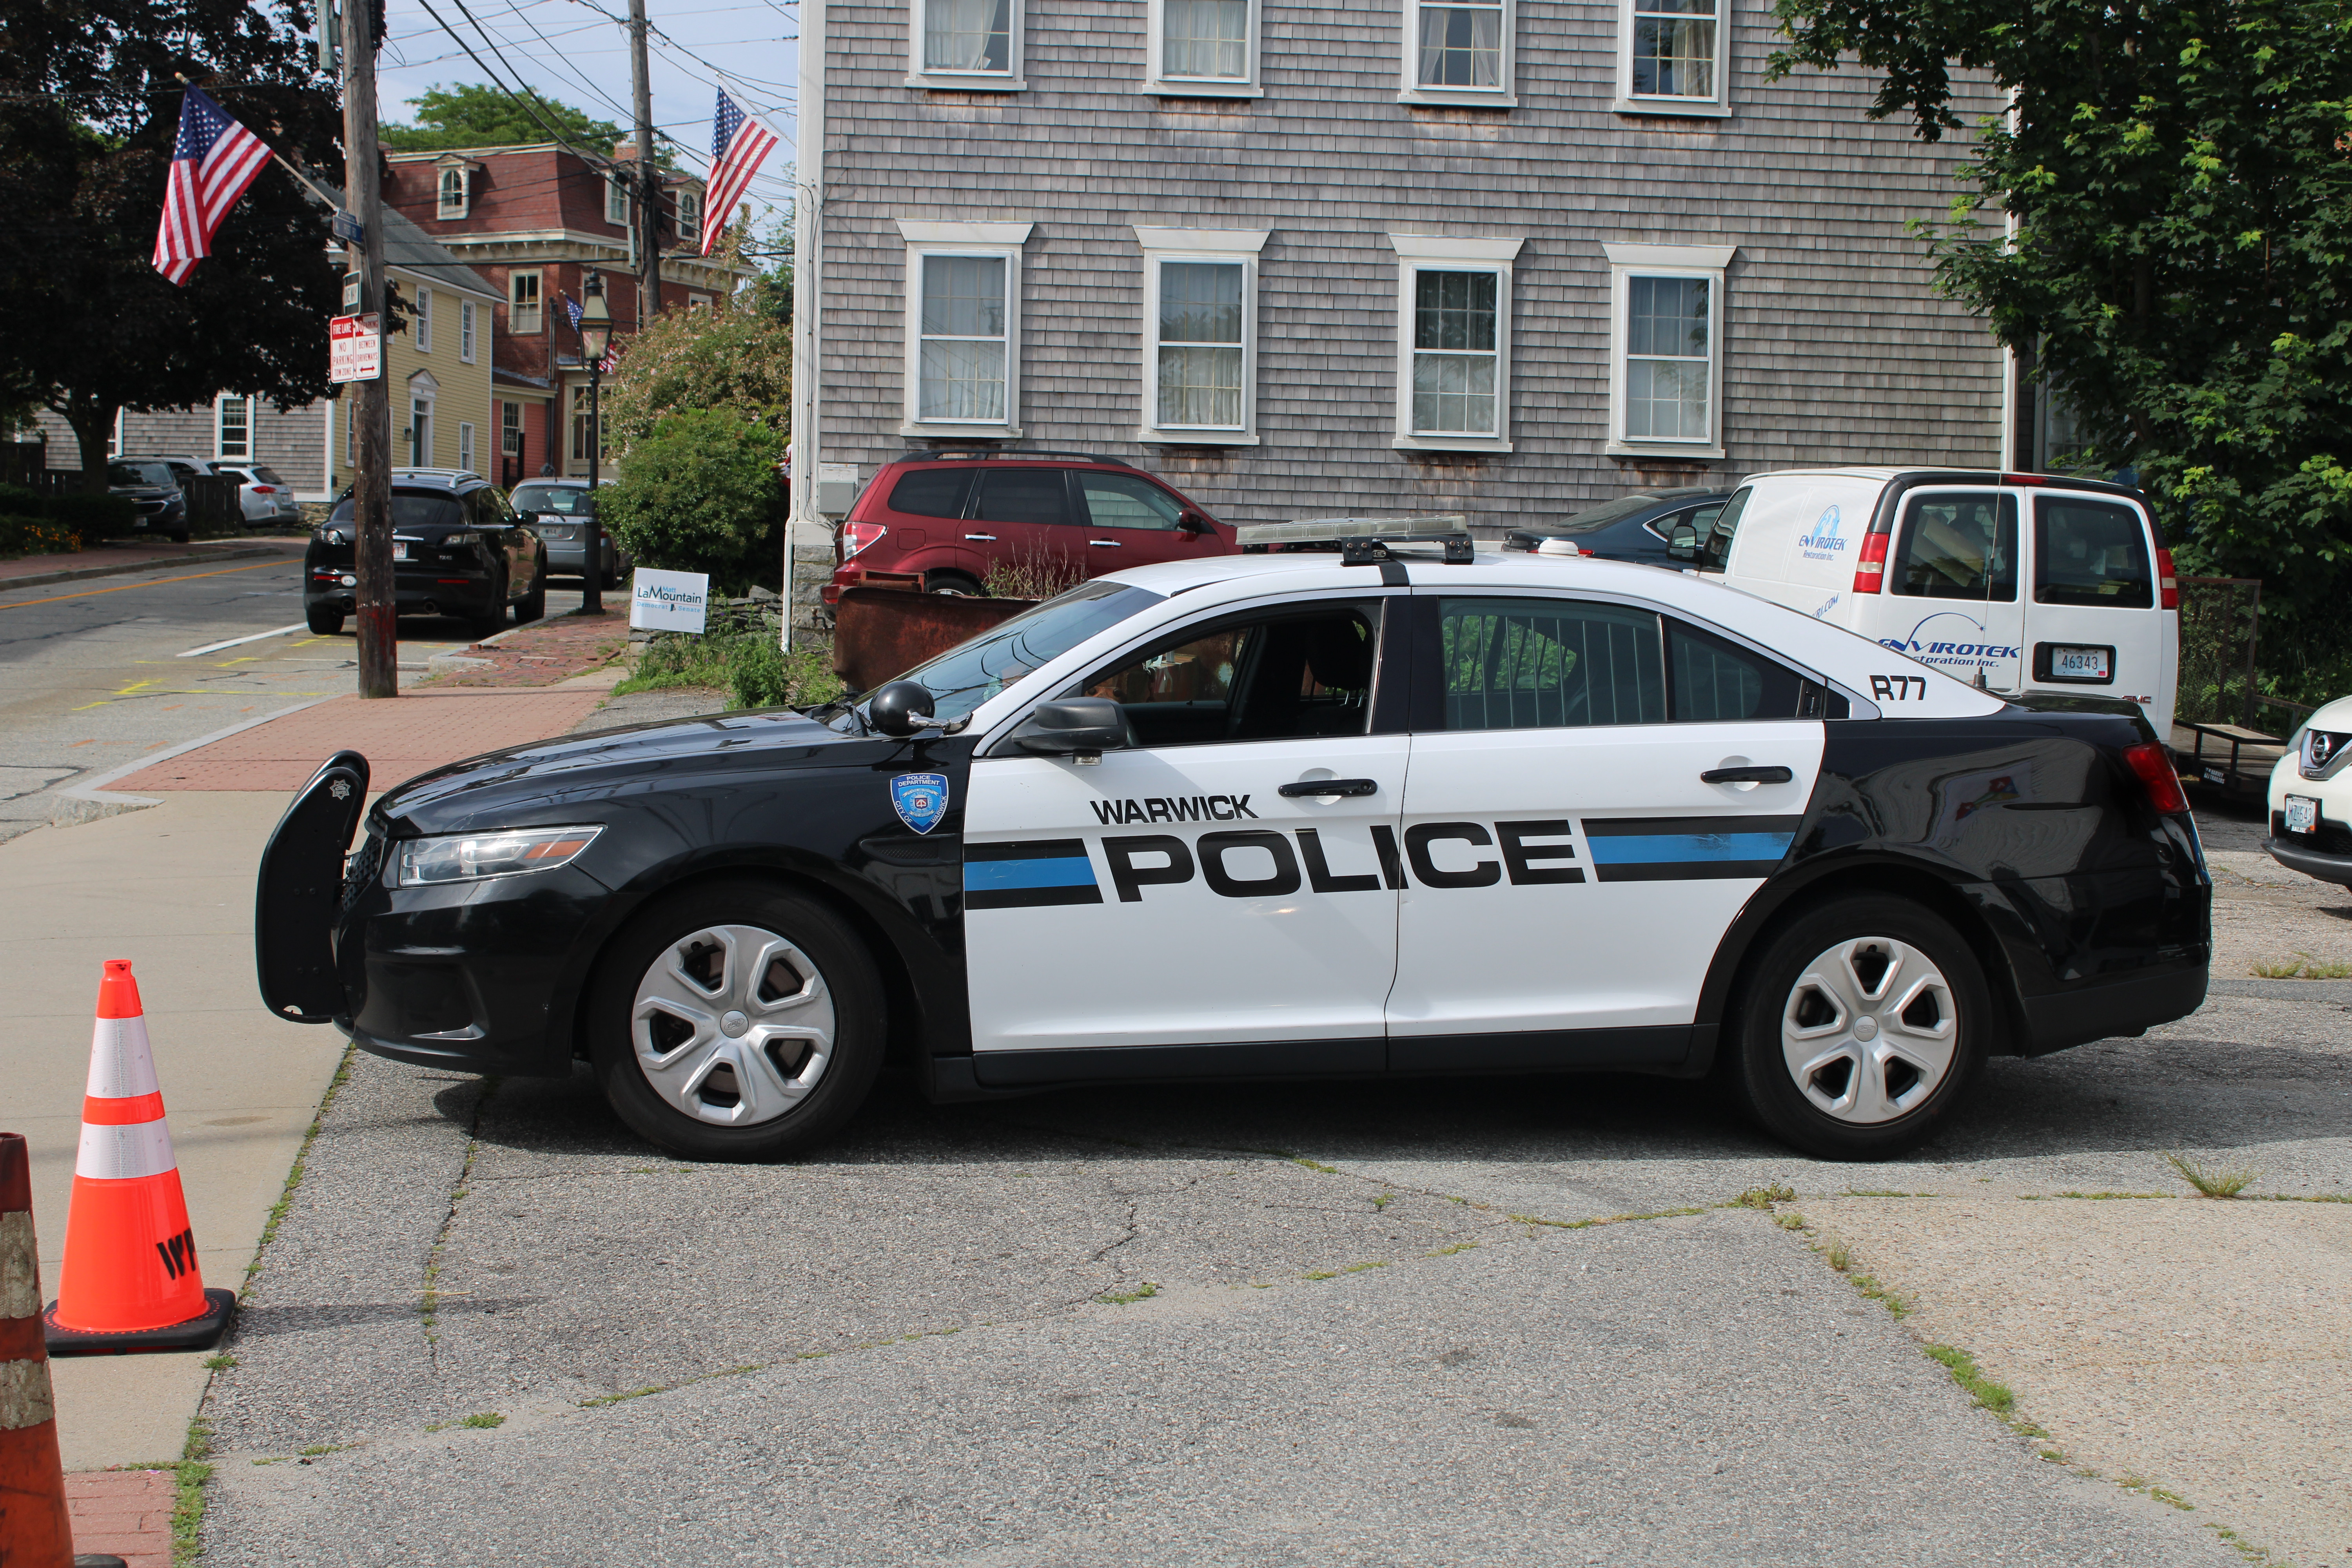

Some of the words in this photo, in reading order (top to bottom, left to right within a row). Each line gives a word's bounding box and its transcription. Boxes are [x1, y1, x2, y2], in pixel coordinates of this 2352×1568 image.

[341, 322, 352, 334] LANE
[355, 320, 363, 333] NO
[339, 342, 347, 353] NO
[359, 339, 376, 349] BETWEEN
[333, 354, 353, 366] PARKING
[358, 353, 378, 362] DRIVEWAYS
[342, 367, 352, 376] ZONE
[1799, 535, 1848, 551] ENVIROTEK
[1802, 550, 1826, 560] Restoration
[637, 585, 702, 604] LaMountain
[637, 601, 668, 610] Democrat
[1878, 639, 2022, 658] ENVIROTEK
[1976, 659, 1999, 667] Inc.
[2062, 655, 2098, 670] 46343
[1869, 675, 1926, 701] R77
[895, 800, 906, 814] CITY
[904, 815, 913, 823] OF
[930, 795, 947, 824] WARWICK
[1090, 794, 1259, 825] WARWICK
[1101, 819, 1586, 903] POLICE
